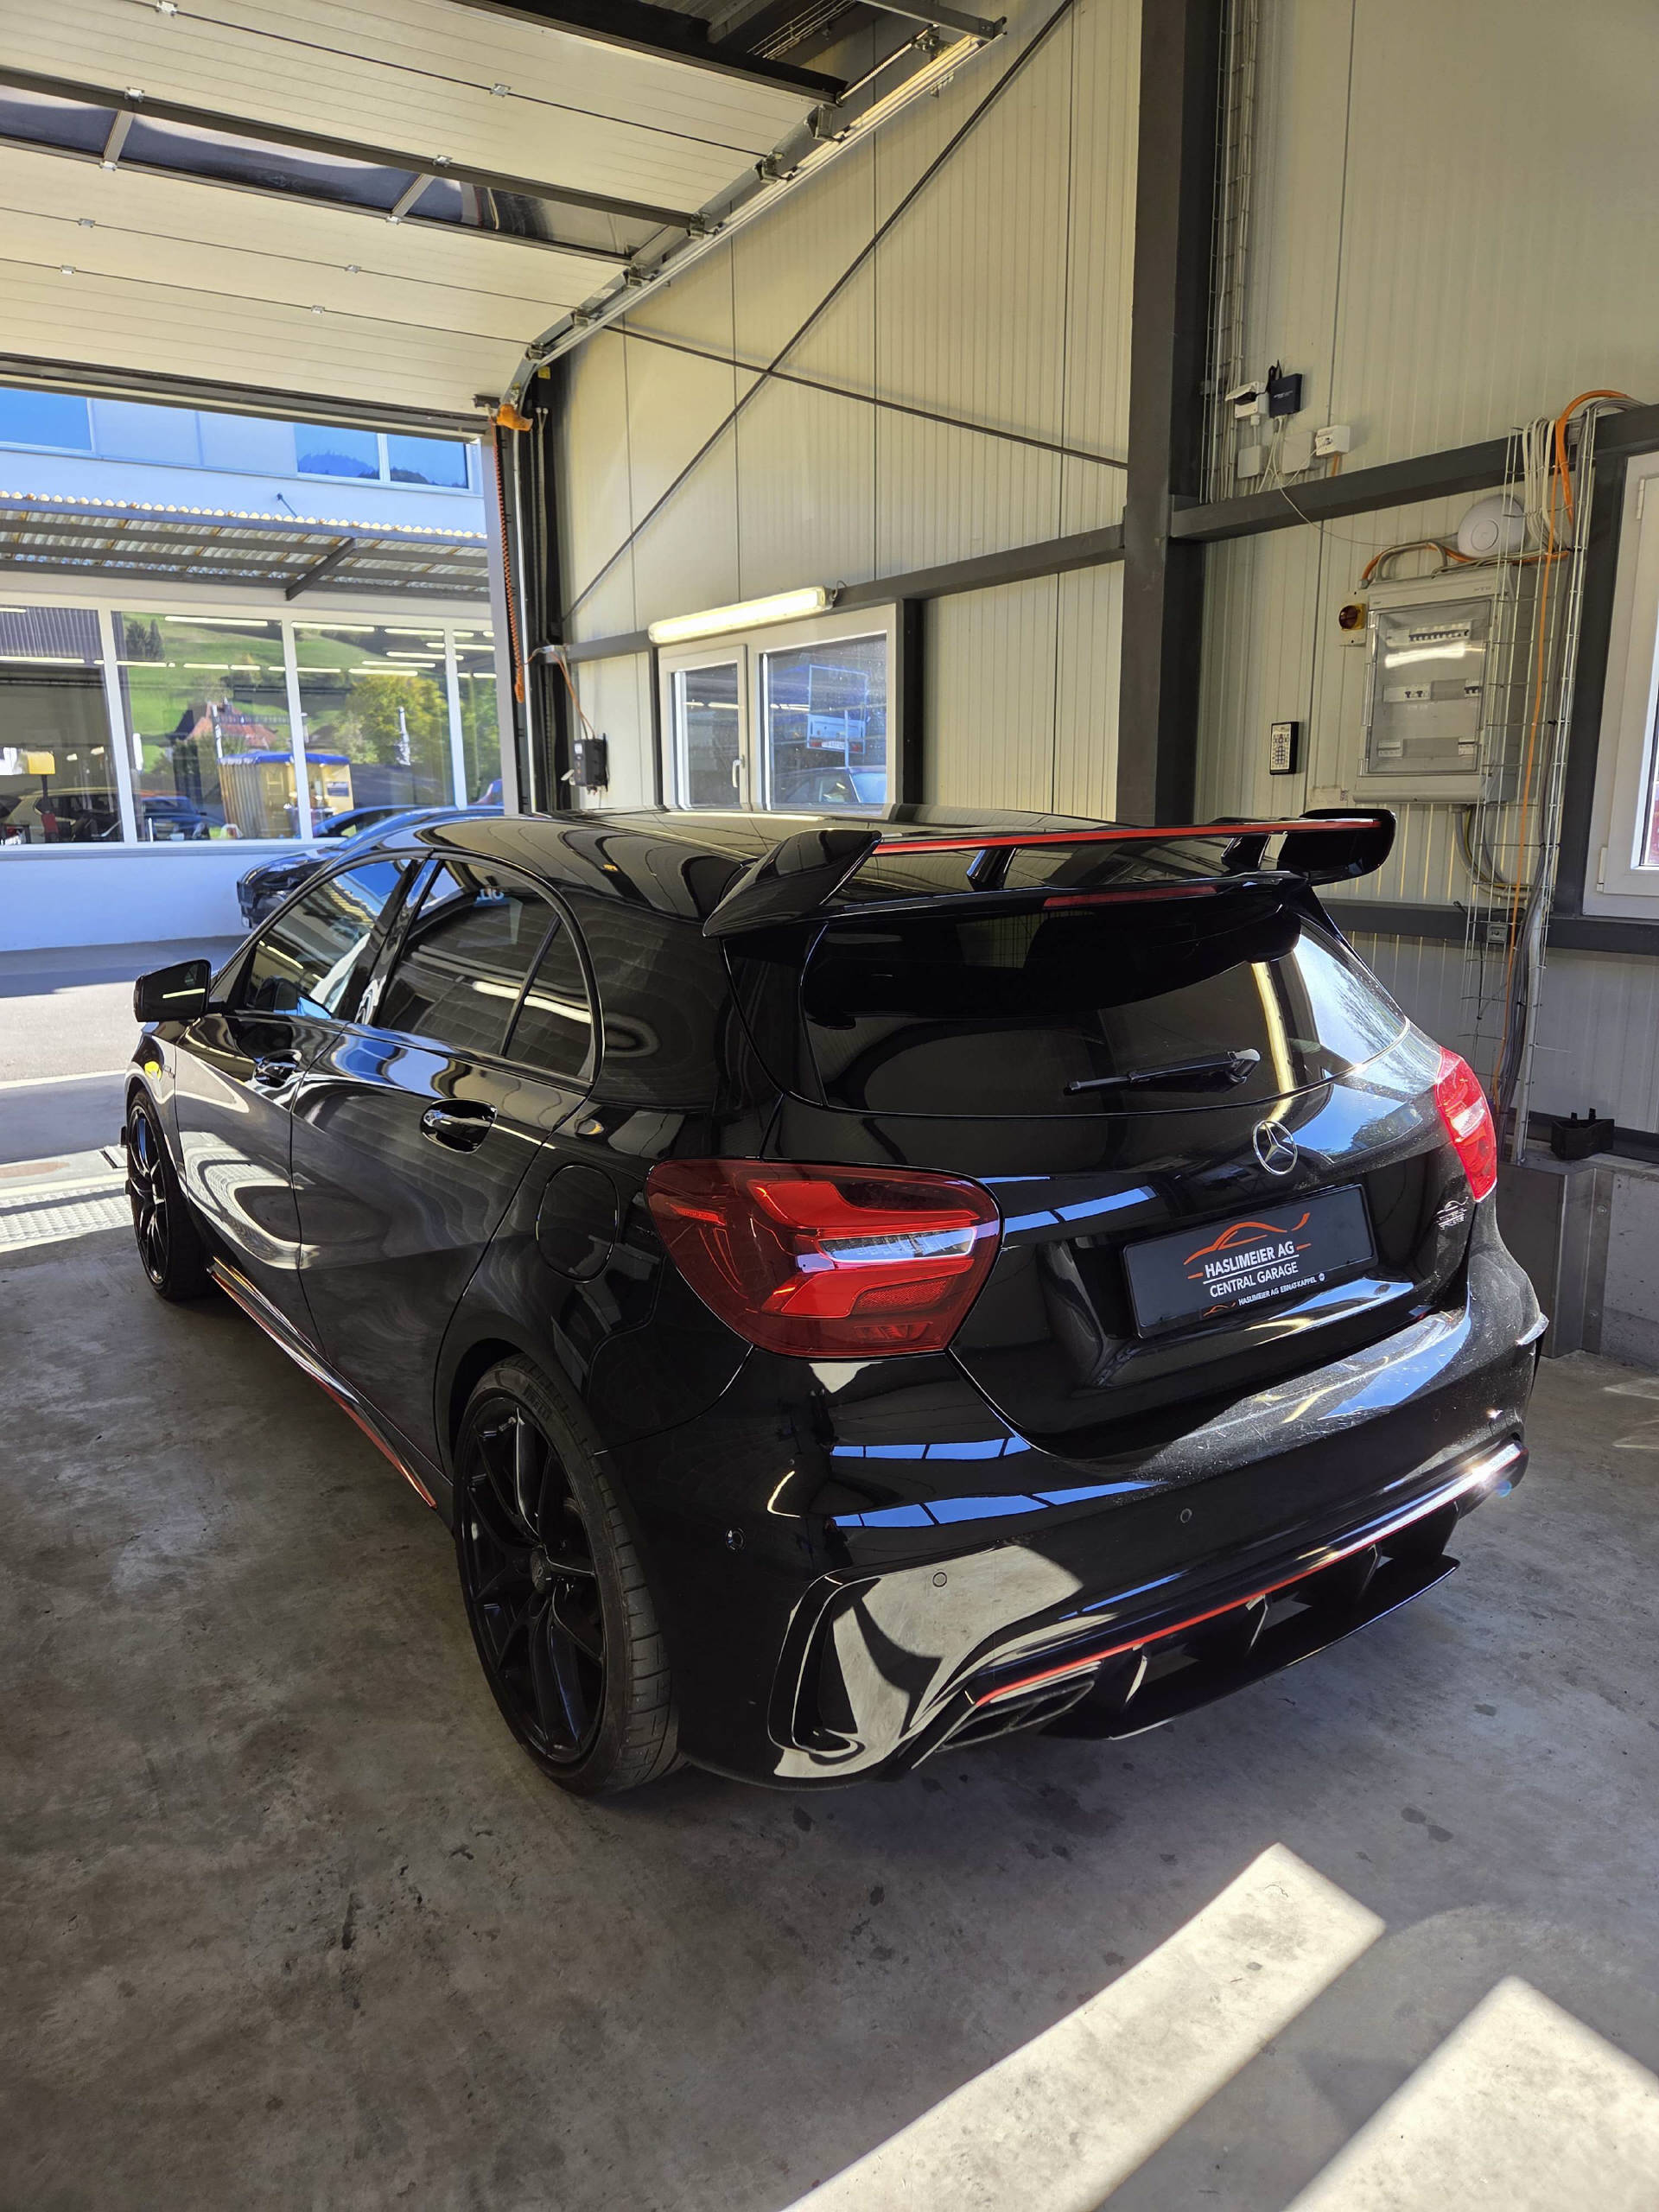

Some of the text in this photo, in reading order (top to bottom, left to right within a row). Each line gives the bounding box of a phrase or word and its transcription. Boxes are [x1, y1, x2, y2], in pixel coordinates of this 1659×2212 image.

[1205, 1241, 1295, 1278] HASLIMEIER AG
[1210, 1274, 1256, 1298] CENTRAL
[1256, 1262, 1299, 1283] GARAGE
[1238, 1290, 1270, 1306] HASLIMEIER
[1270, 1287, 1280, 1296] AG
[1280, 1276, 1317, 1293] EBNAT-KAPPEL
